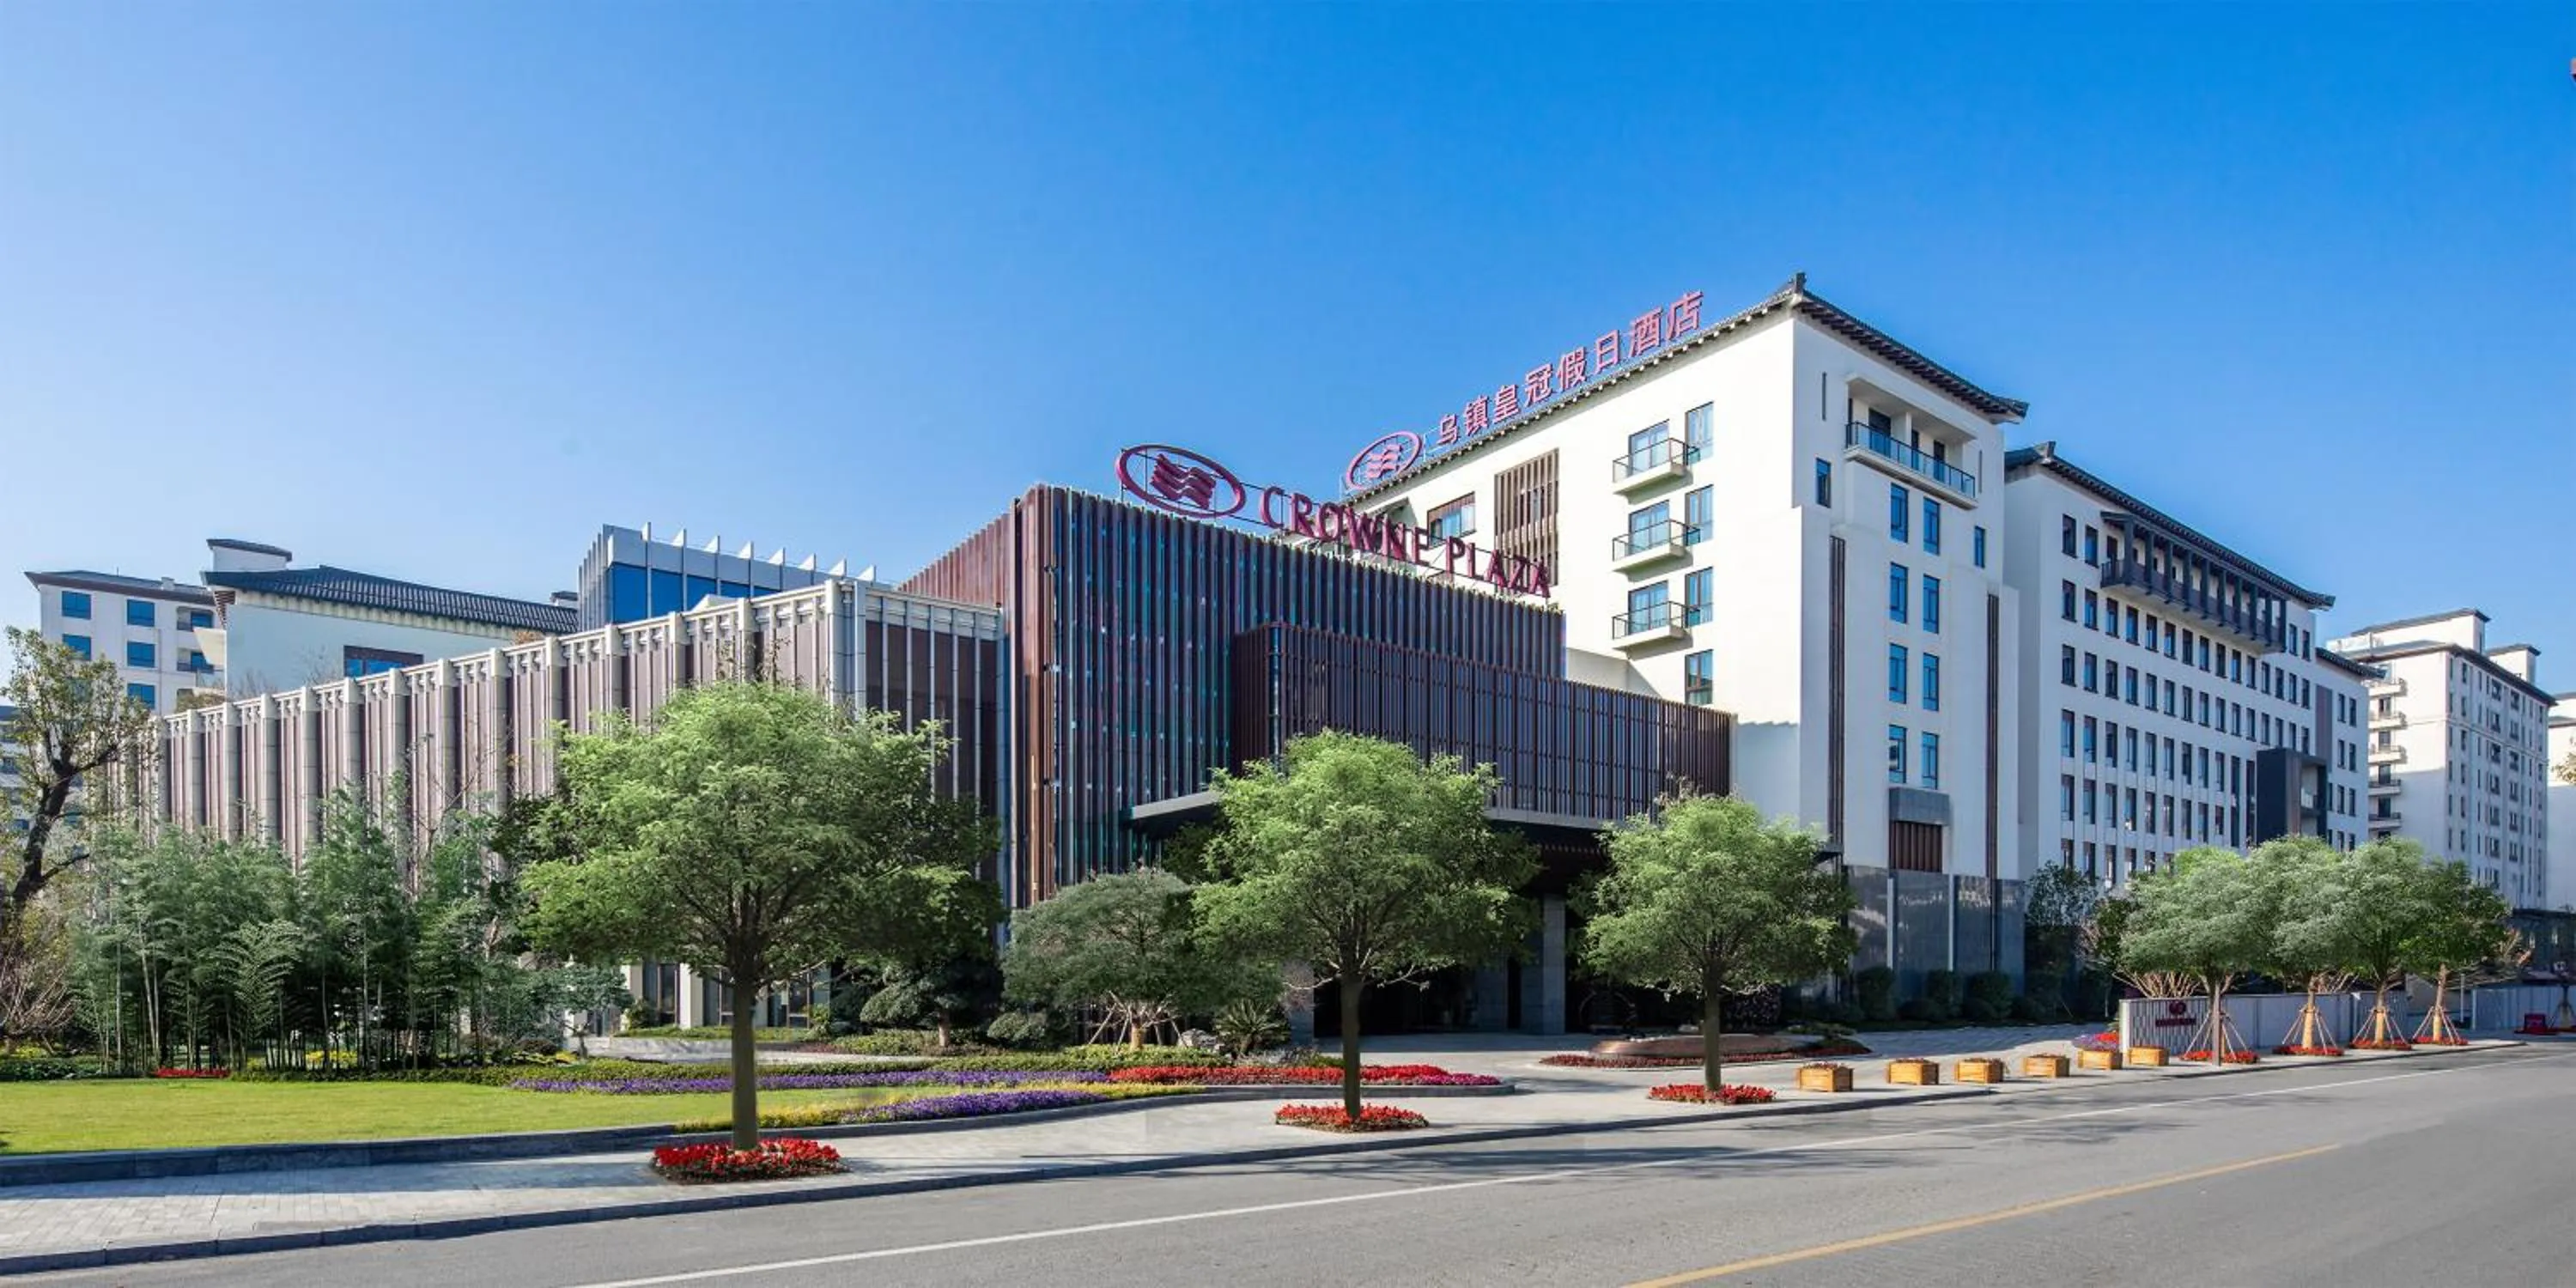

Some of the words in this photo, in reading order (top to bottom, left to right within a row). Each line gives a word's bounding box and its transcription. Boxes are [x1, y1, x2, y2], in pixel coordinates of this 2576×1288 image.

[1437, 289, 1704, 445] 乌镇皇冠假日酒店
[1260, 485, 1431, 567] CROWNE
[1446, 535, 1552, 598] PLAZA
